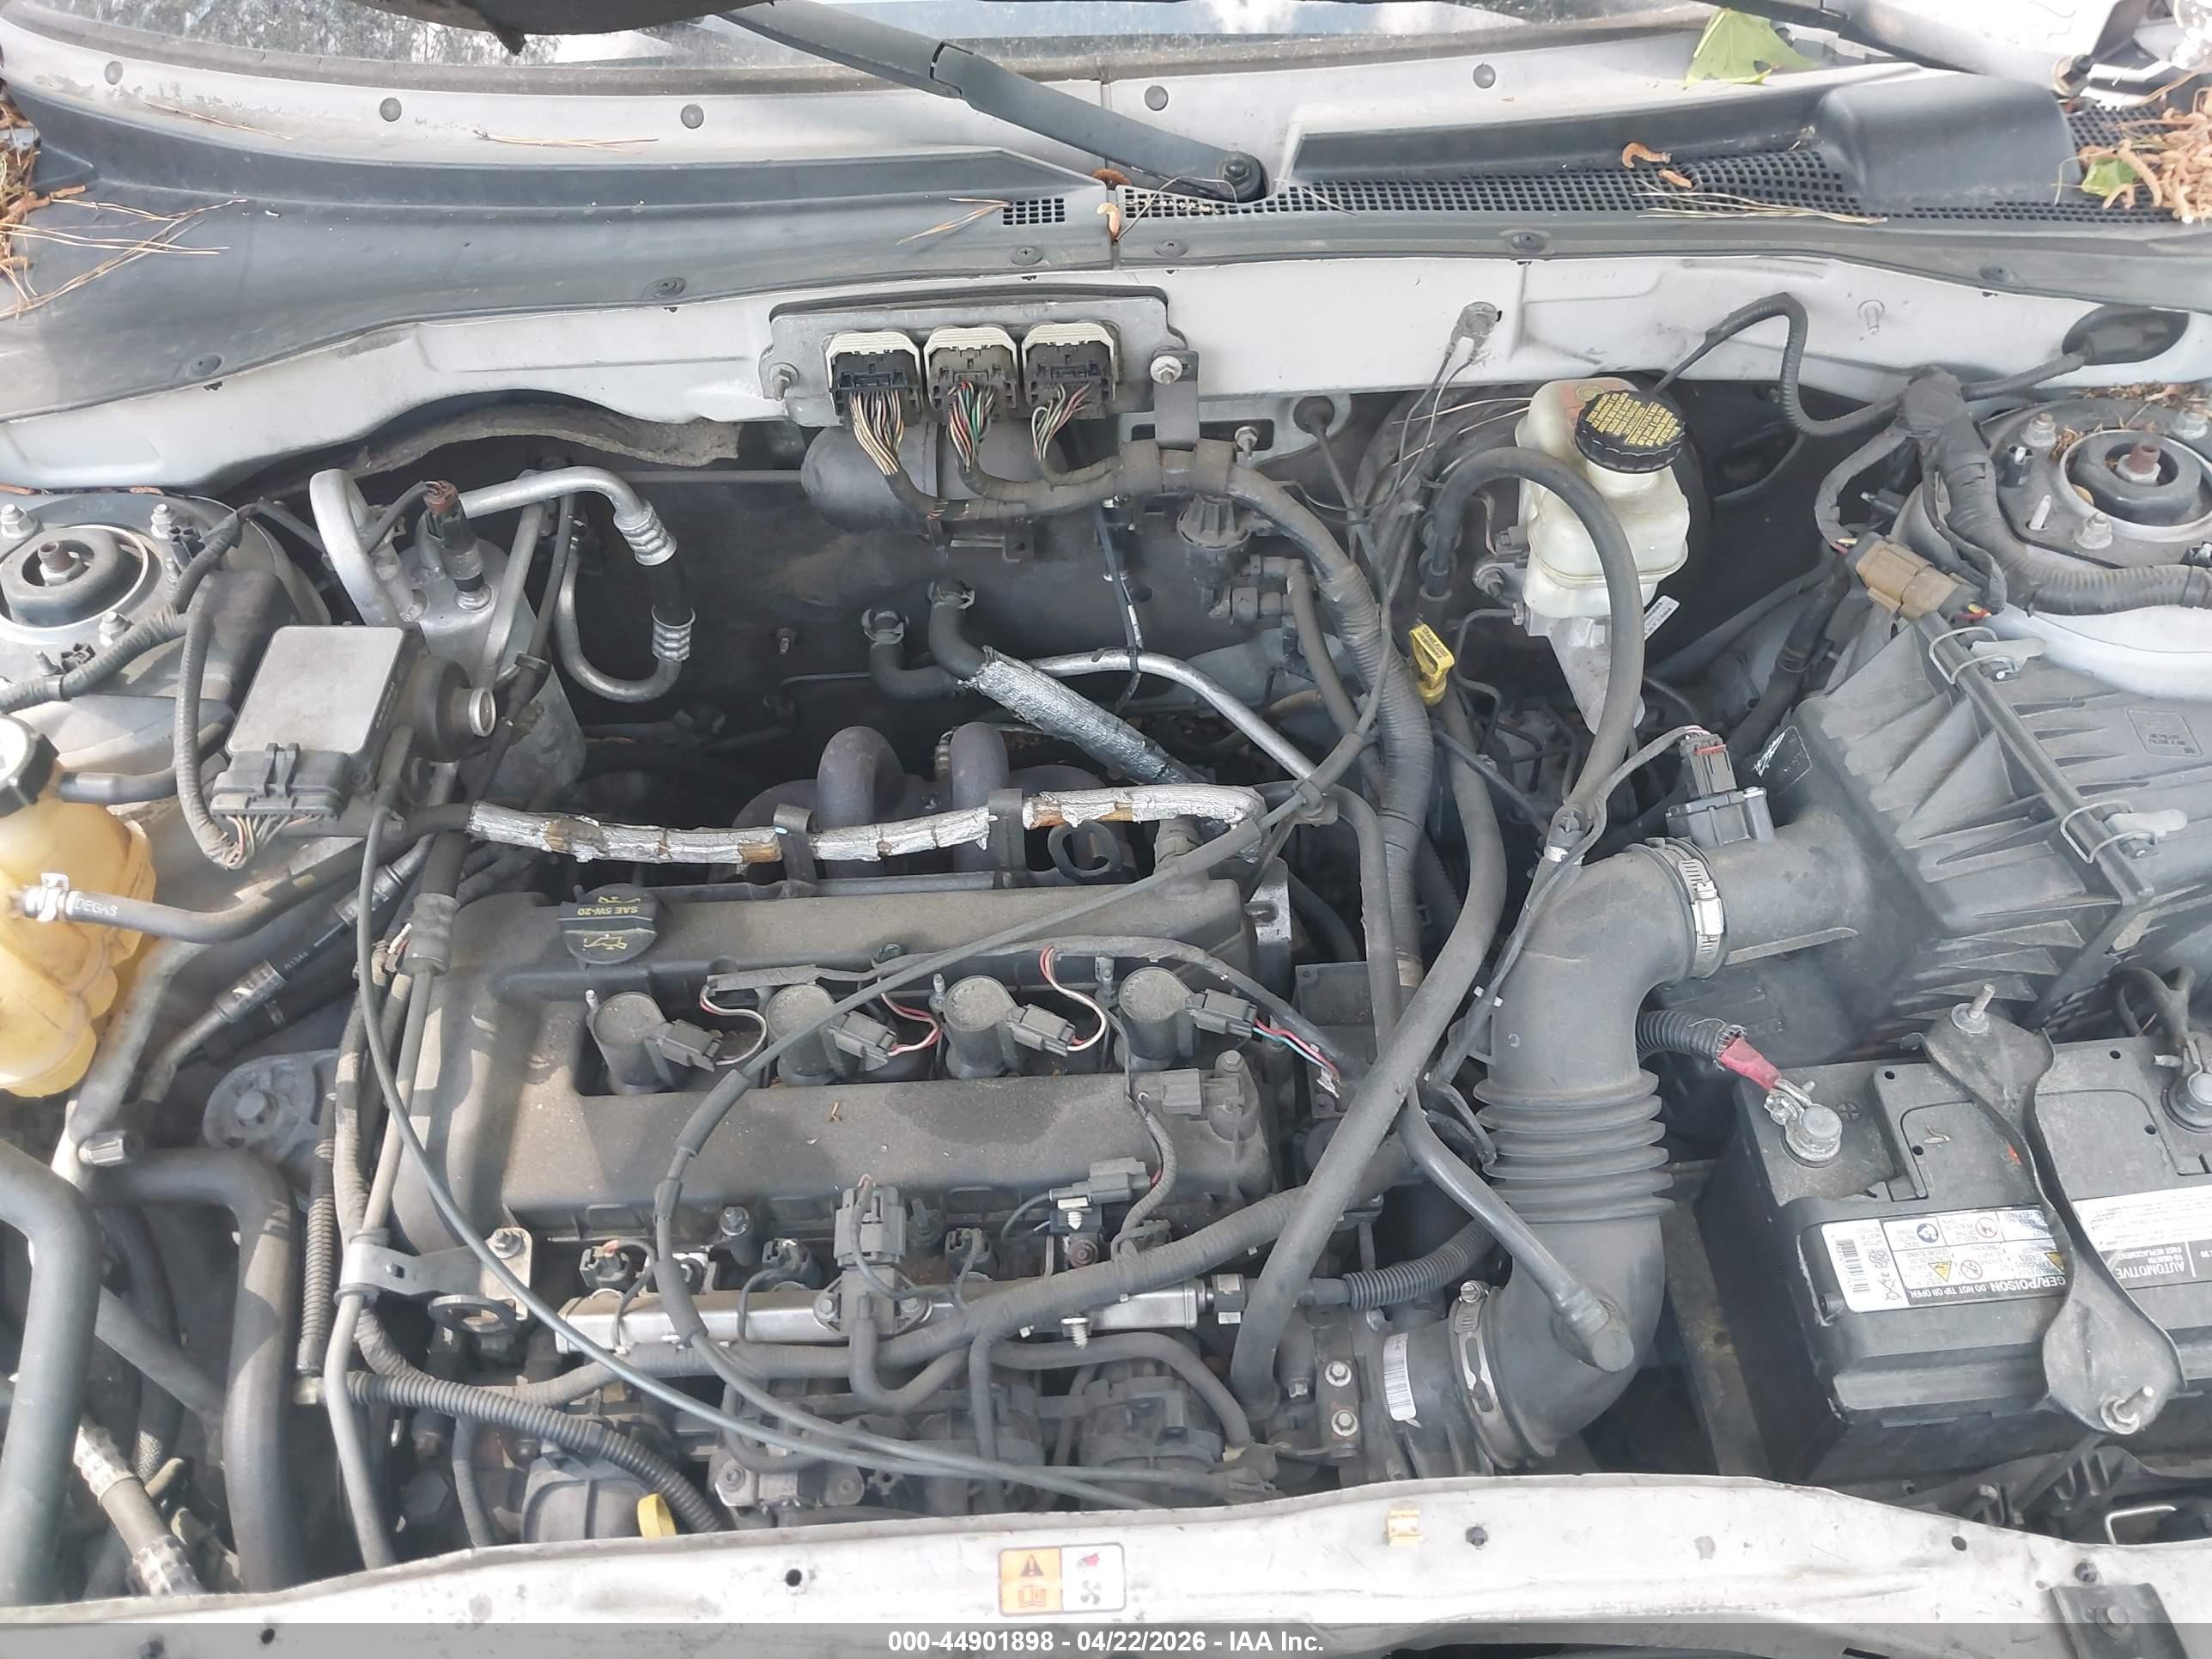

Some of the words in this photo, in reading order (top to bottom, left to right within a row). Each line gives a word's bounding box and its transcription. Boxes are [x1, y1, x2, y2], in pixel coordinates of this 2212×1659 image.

[74, 897, 118, 916] DEGAS
[577, 907, 611, 915] 5W-20
[614, 906, 639, 915] SAE
[2115, 1261, 2185, 1278] AUTOMOTIVE
[1942, 1286, 1957, 1295] TIP
[1957, 1285, 1974, 1293] NOT
